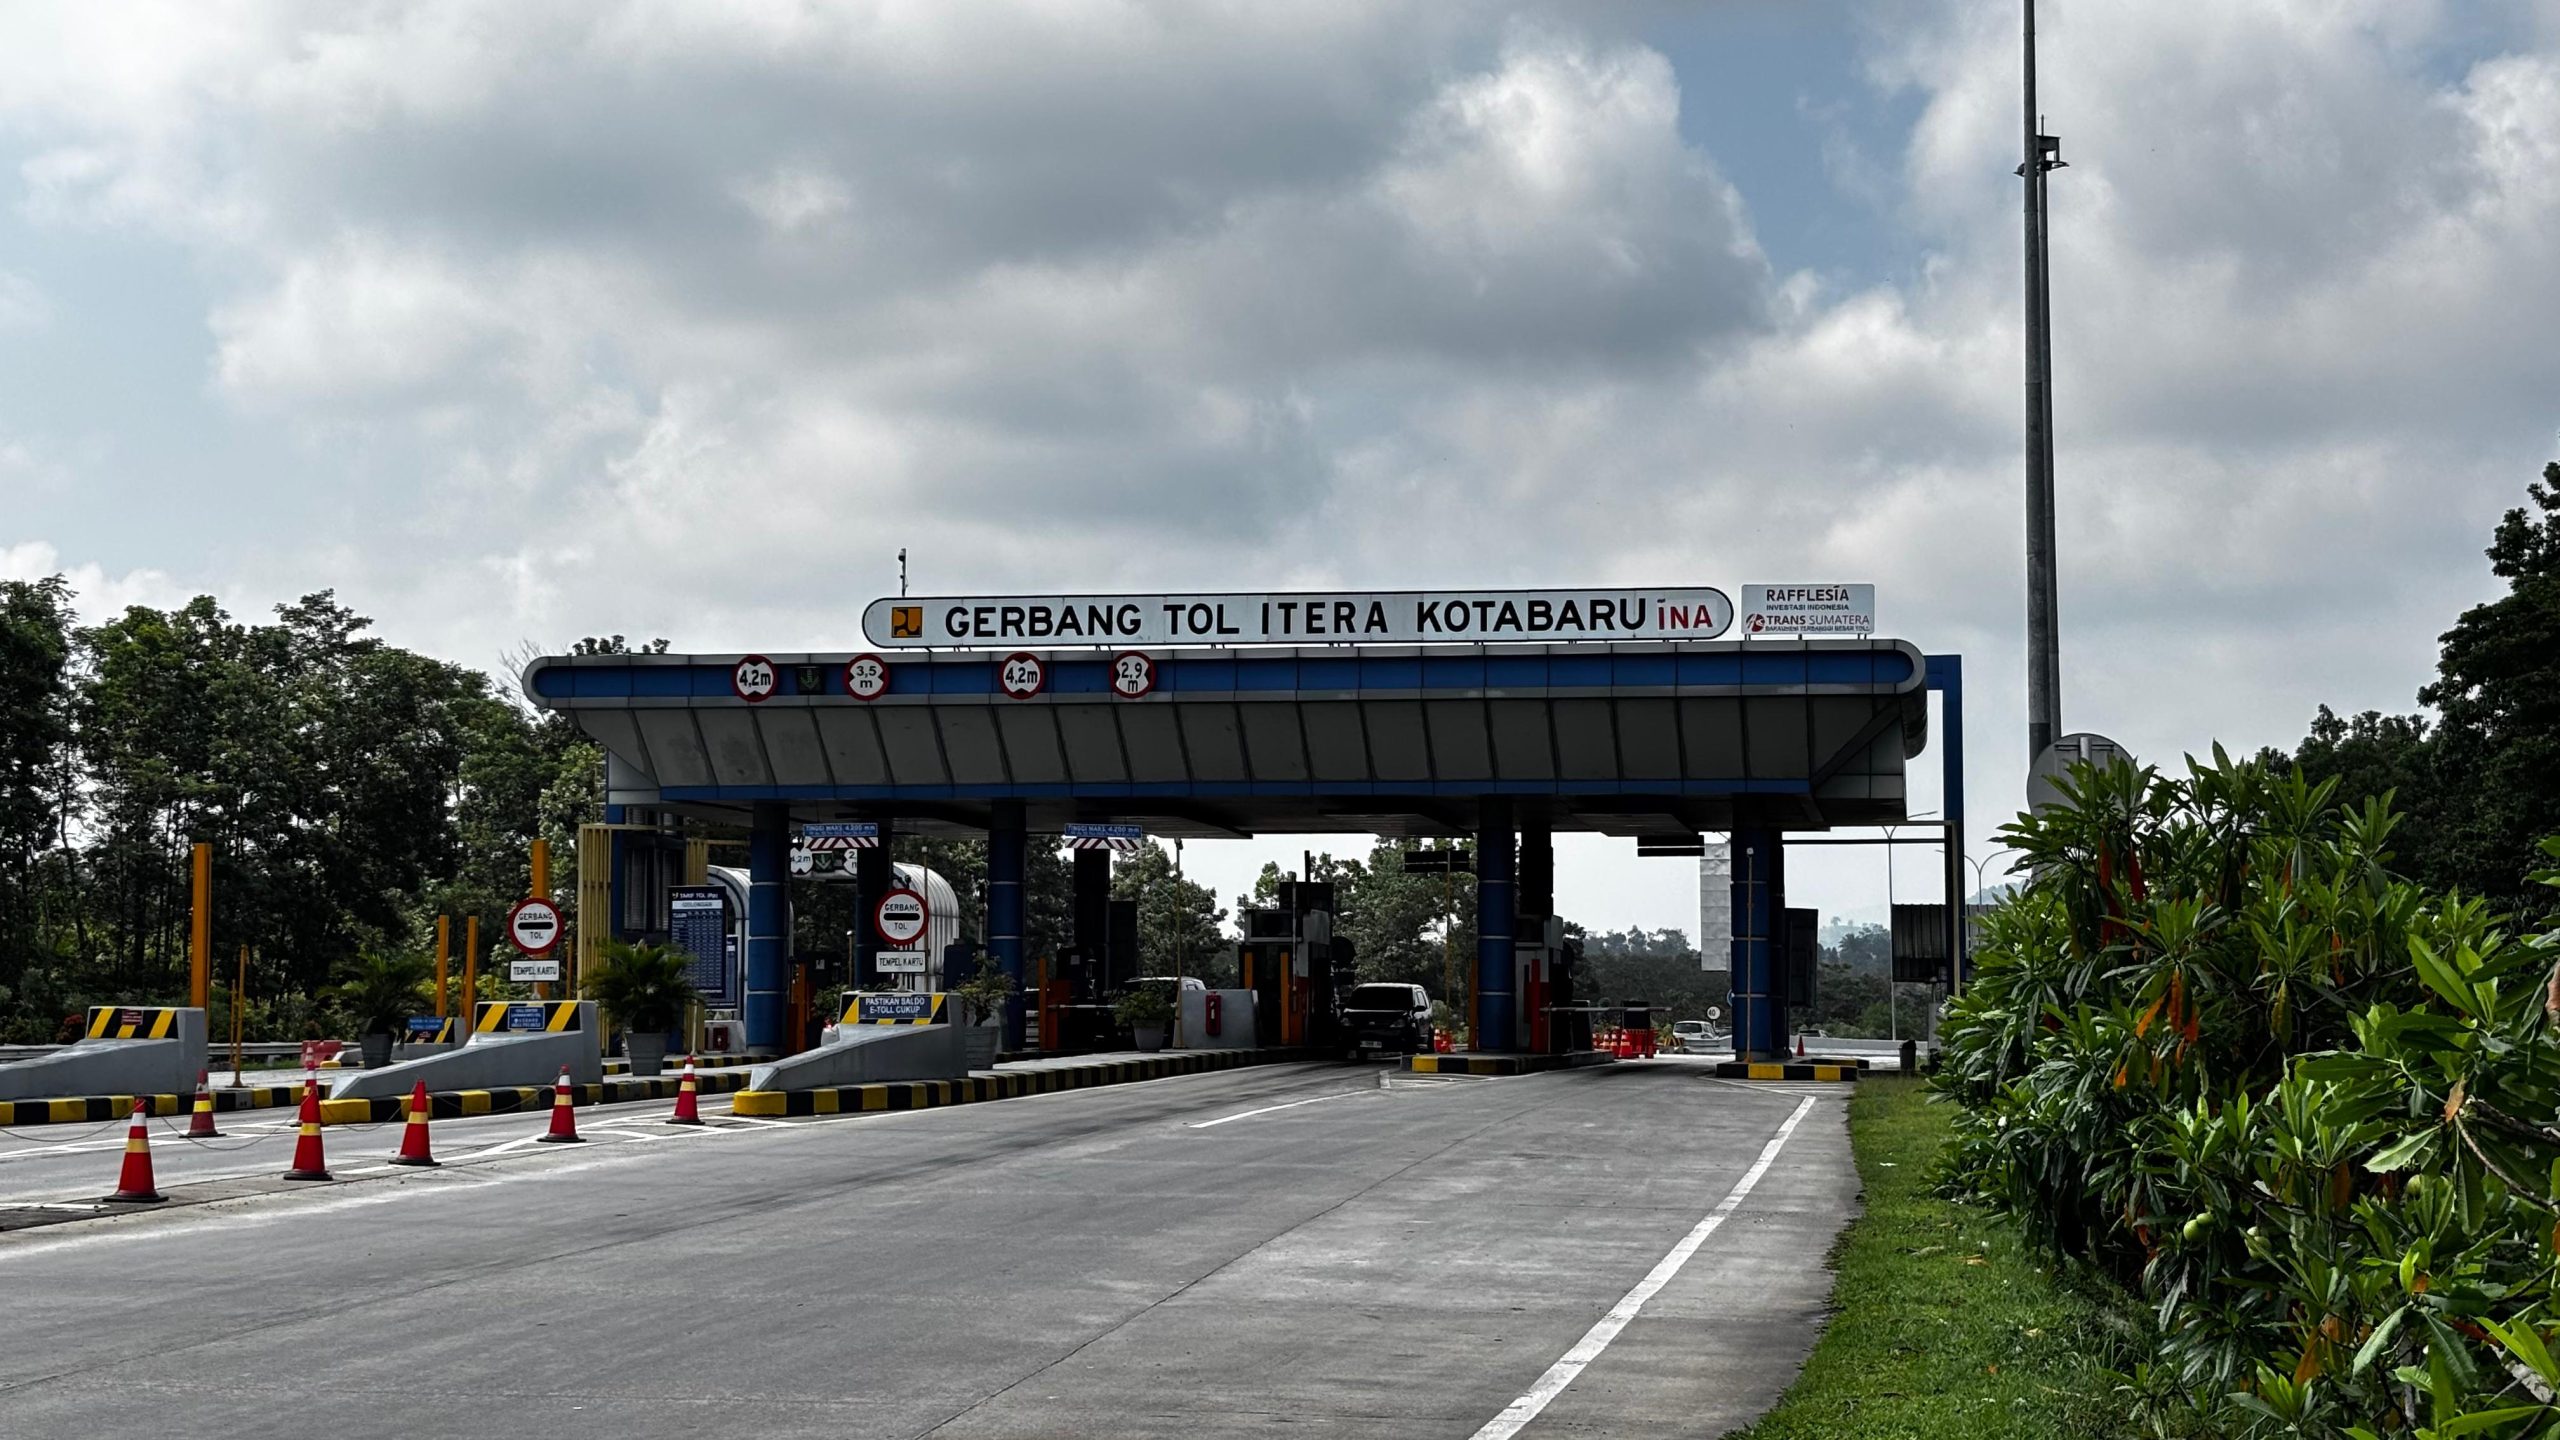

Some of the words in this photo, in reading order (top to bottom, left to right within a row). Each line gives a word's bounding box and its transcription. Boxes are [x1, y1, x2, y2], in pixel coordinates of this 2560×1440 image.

[945, 604, 1142, 638] GERBANG
[1163, 603, 1240, 635] TOL
[1260, 601, 1389, 634] ITERA
[1417, 597, 1646, 633] KOTABARU
[1766, 615, 1806, 625] TRANS
[1808, 615, 1870, 626] SUMATERA
[857, 665, 877, 677] 3,5
[1005, 666, 1038, 685] 4,2m
[860, 678, 873, 688] m
[1127, 679, 1138, 692] m
[894, 922, 907, 930] TOL
[530, 931, 543, 939] TOL
[879, 958, 902, 966] TEMPEL
[902, 958, 923, 966] KARTU
[513, 967, 535, 975] TEMPEL
[537, 967, 557, 975] KARTU
[901, 997, 925, 1005] SALDO
